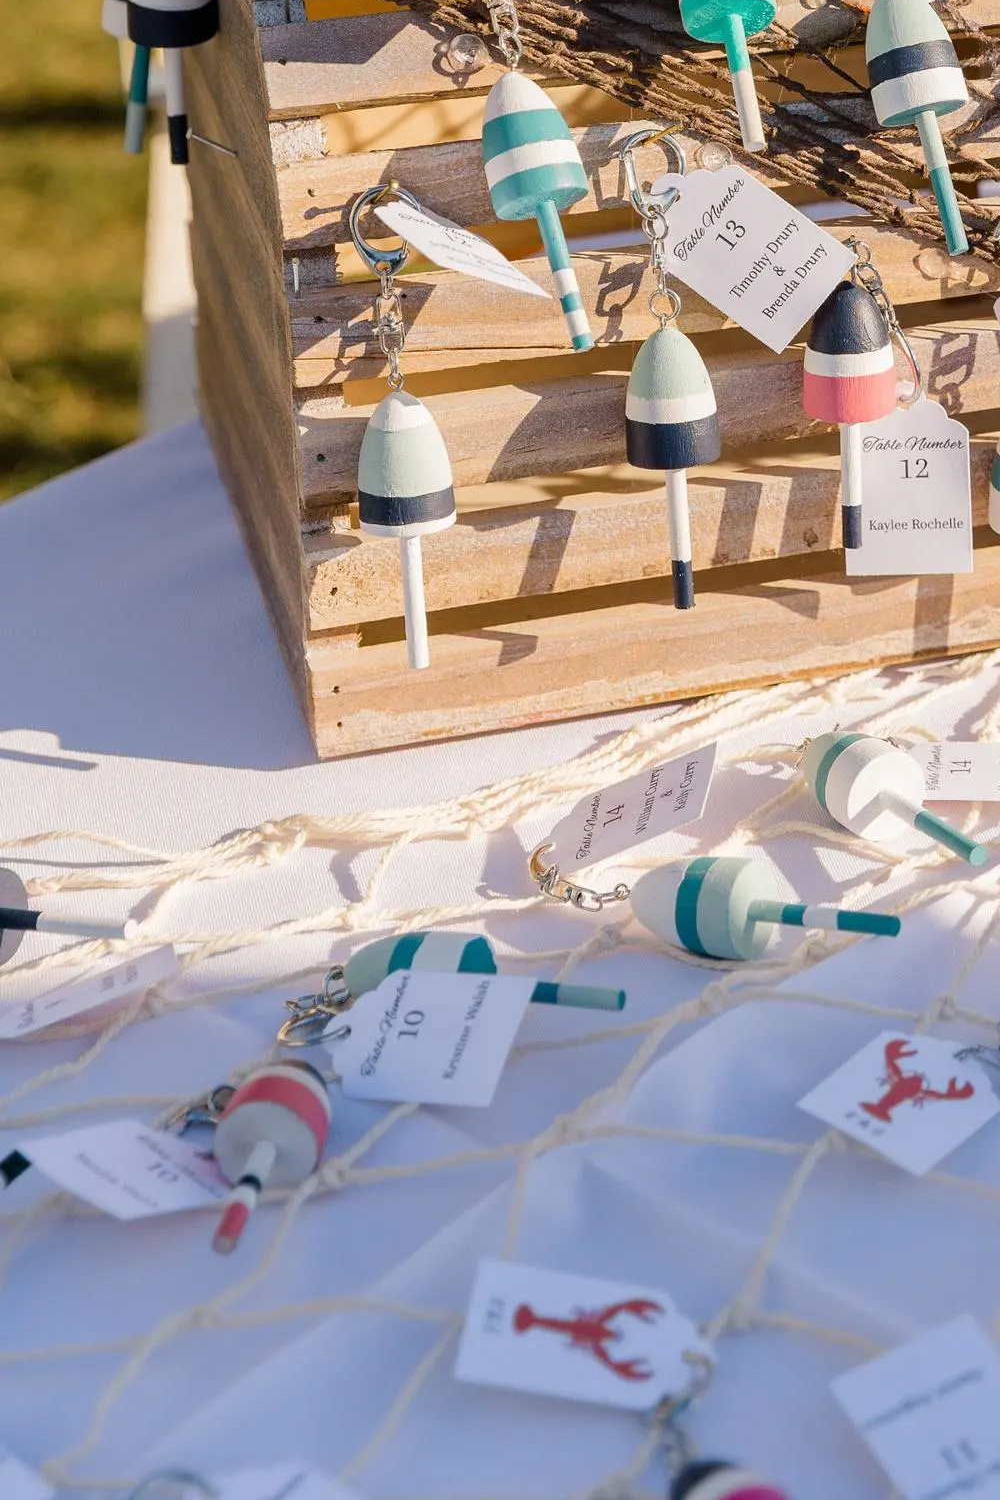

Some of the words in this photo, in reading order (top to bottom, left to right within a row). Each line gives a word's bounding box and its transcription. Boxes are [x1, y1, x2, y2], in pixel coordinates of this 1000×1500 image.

[673, 228, 706, 262] Table
[702, 178, 745, 228] Number
[715, 219, 746, 252] 13
[729, 252, 773, 301] Timothy
[766, 218, 800, 255] Drury
[772, 265, 788, 278] &
[761, 276, 800, 321] Brenda
[794, 243, 829, 280] Drury
[862, 436, 902, 453] Table
[904, 436, 965, 451] Number
[900, 458, 930, 479] 12
[869, 519, 908, 534] Kaylee
[911, 517, 964, 530] Rochelle
[927, 744, 943, 773] Number
[950, 760, 972, 775] 14
[680, 761, 699, 789] Curry
[635, 796, 655, 835] William
[645, 767, 664, 797] Curry
[660, 789, 674, 799] &
[673, 788, 693, 813] Kelly
[584, 792, 602, 831] Number
[603, 803, 625, 828] 14
[575, 831, 594, 860] Table
[360, 1035, 387, 1078] Table
[379, 973, 411, 1035] Number
[397, 1009, 426, 1040] 10
[441, 1024, 473, 1081] Kristine
[464, 979, 492, 1022] Walsh
